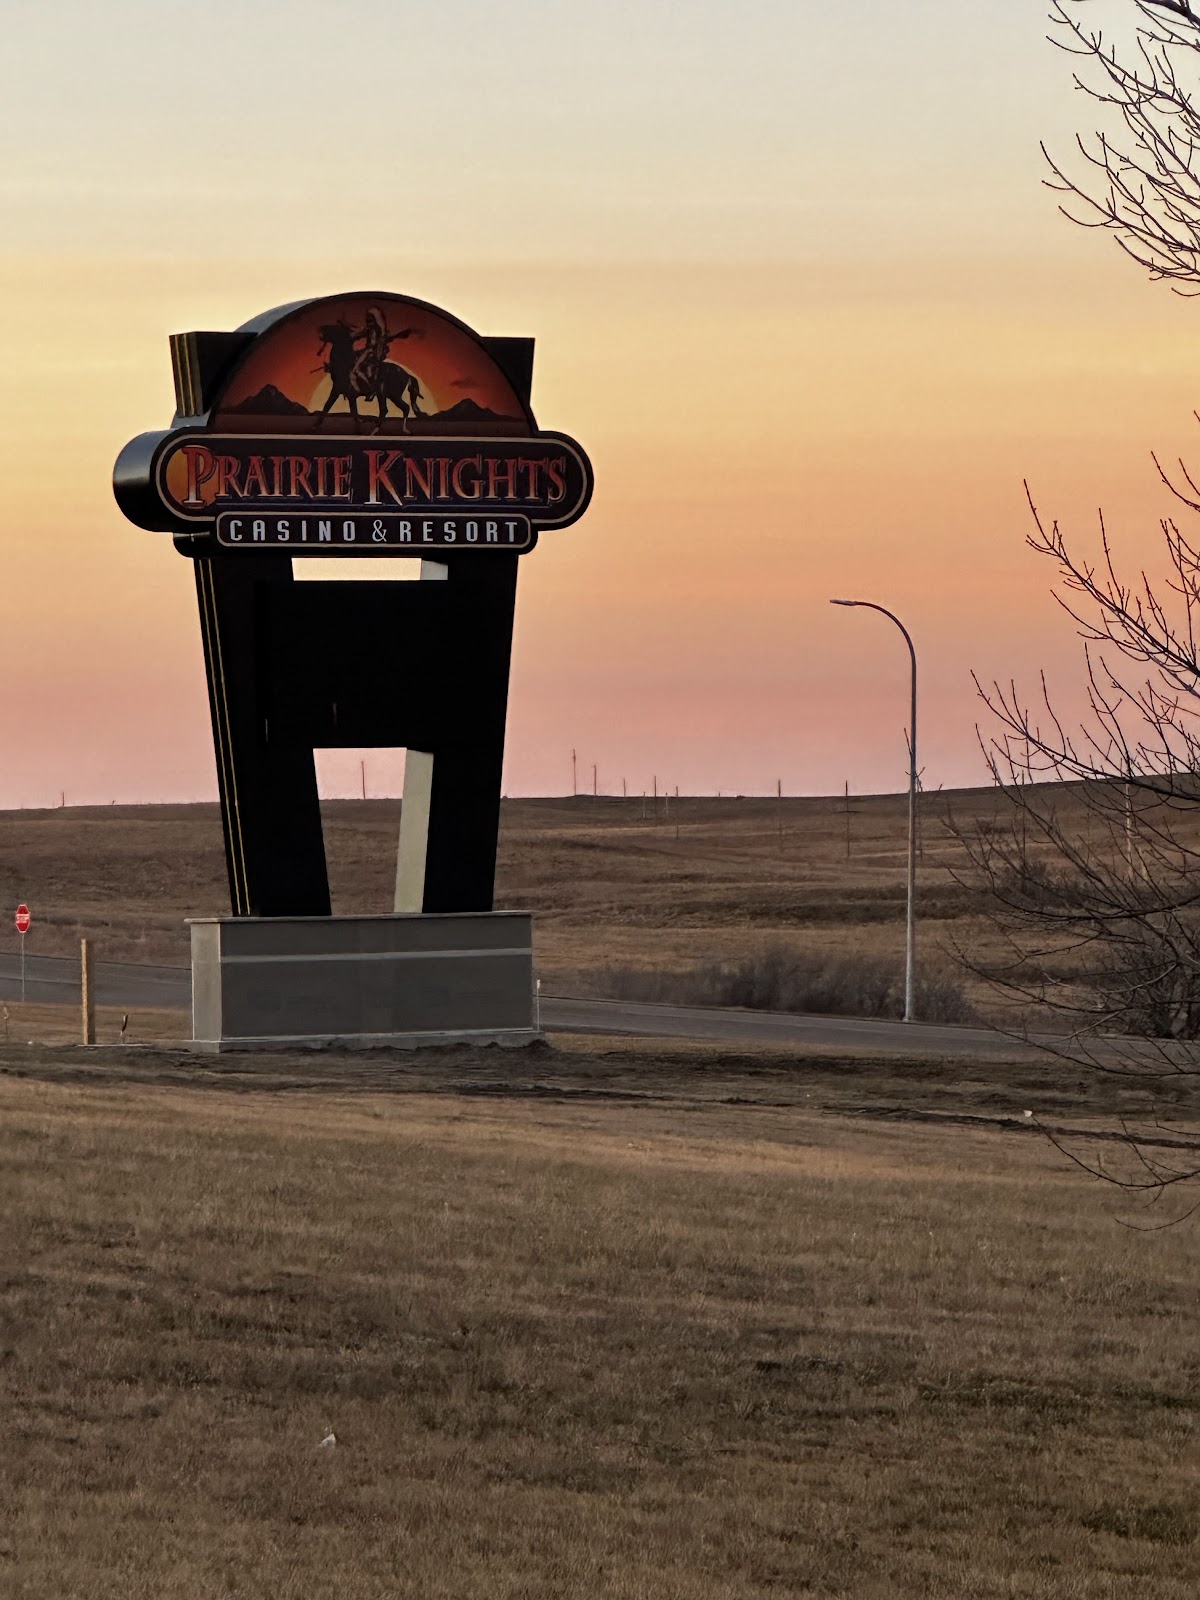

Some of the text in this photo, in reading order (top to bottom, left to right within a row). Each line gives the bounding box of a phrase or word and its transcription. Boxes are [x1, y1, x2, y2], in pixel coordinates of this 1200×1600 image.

[182, 445, 566, 506] PRAIRIE KNIGHTS
[230, 520, 518, 544] CASINO & RESORT
